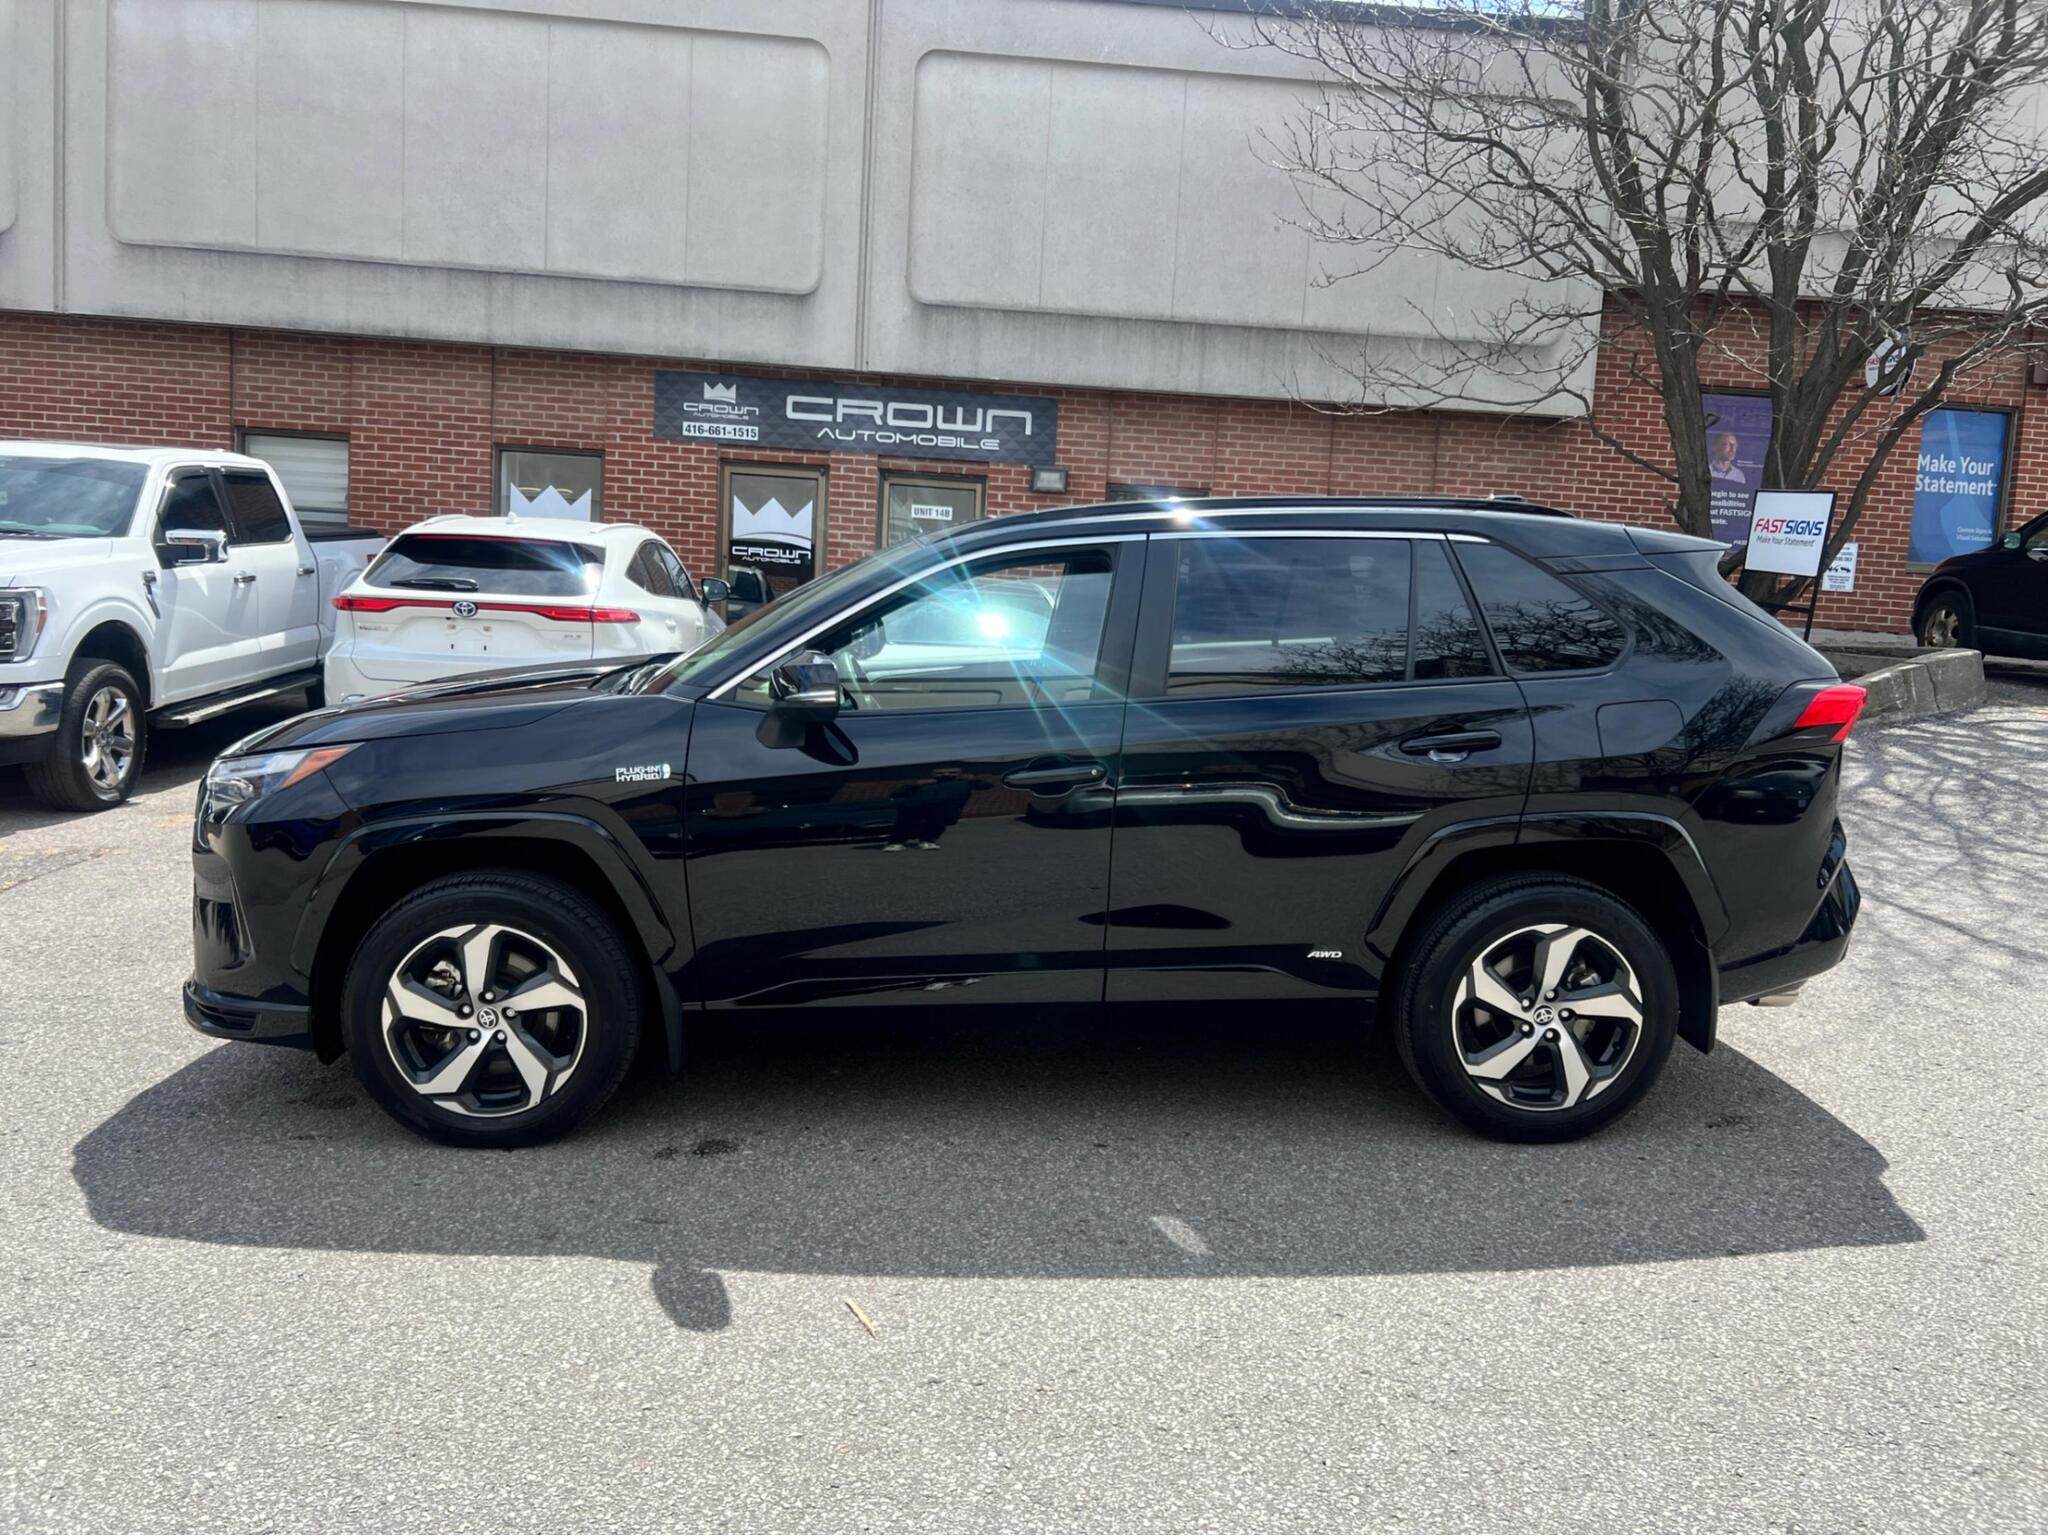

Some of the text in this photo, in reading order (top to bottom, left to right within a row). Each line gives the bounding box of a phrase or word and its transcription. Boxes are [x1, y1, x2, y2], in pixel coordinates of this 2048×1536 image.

[683, 402, 759, 416] CROWN
[786, 395, 1032, 435] CROWN
[684, 424, 757, 438] 416-661-1515
[817, 427, 1000, 450] AUTOMOBILE
[1917, 454, 1994, 476] Make Your
[1915, 474, 1994, 496] Statement
[914, 507, 951, 518] UNIT 14B
[1754, 518, 1824, 536] FASTSIGNS
[1756, 535, 1771, 544] Make
[1772, 536, 1784, 544] Your
[1784, 537, 1815, 547] Statement
[732, 546, 811, 560] CROWN
[742, 556, 801, 565] AUTOMOBILE
[616, 766, 659, 775] PLUG-IN
[616, 772, 659, 782] HYBRID
[1307, 950, 1343, 959] AWD
